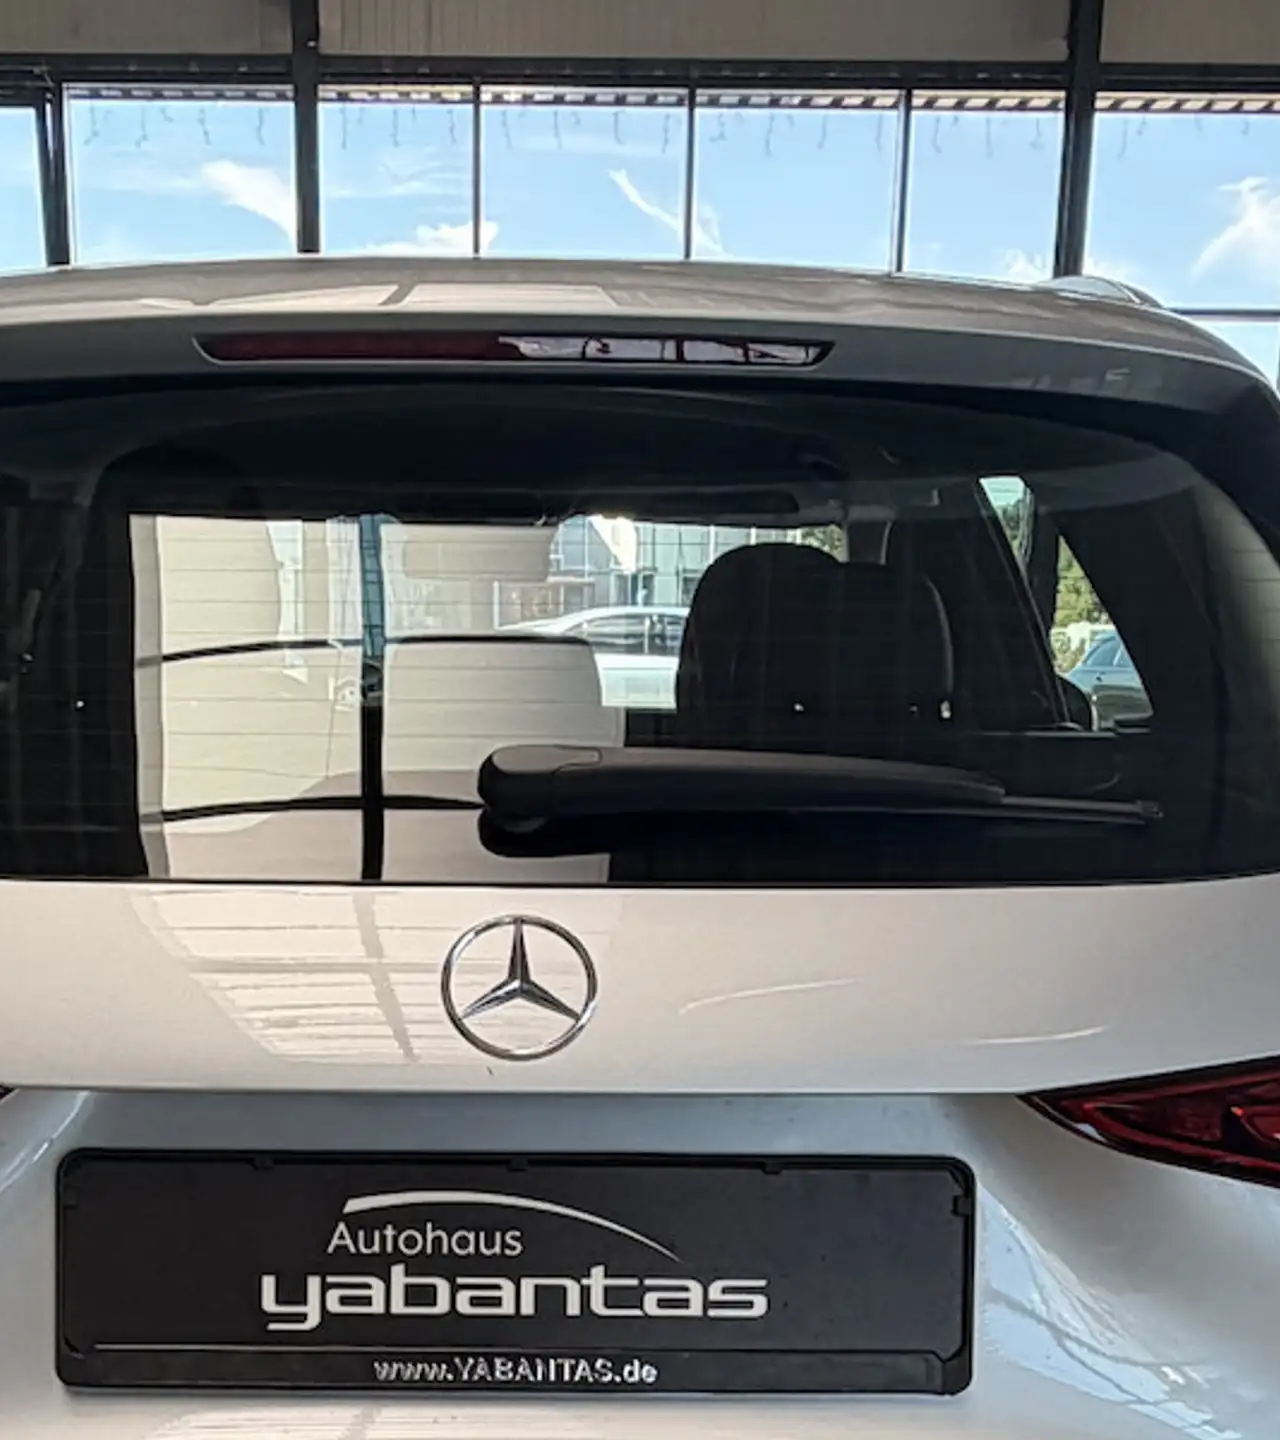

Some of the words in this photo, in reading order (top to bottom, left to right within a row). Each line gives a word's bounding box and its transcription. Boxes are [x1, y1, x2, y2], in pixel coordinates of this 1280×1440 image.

[327, 1221, 522, 1257] Autohaus
[260, 1263, 769, 1332] yabantas
[373, 1356, 658, 1384] www.YABANTAS.de
